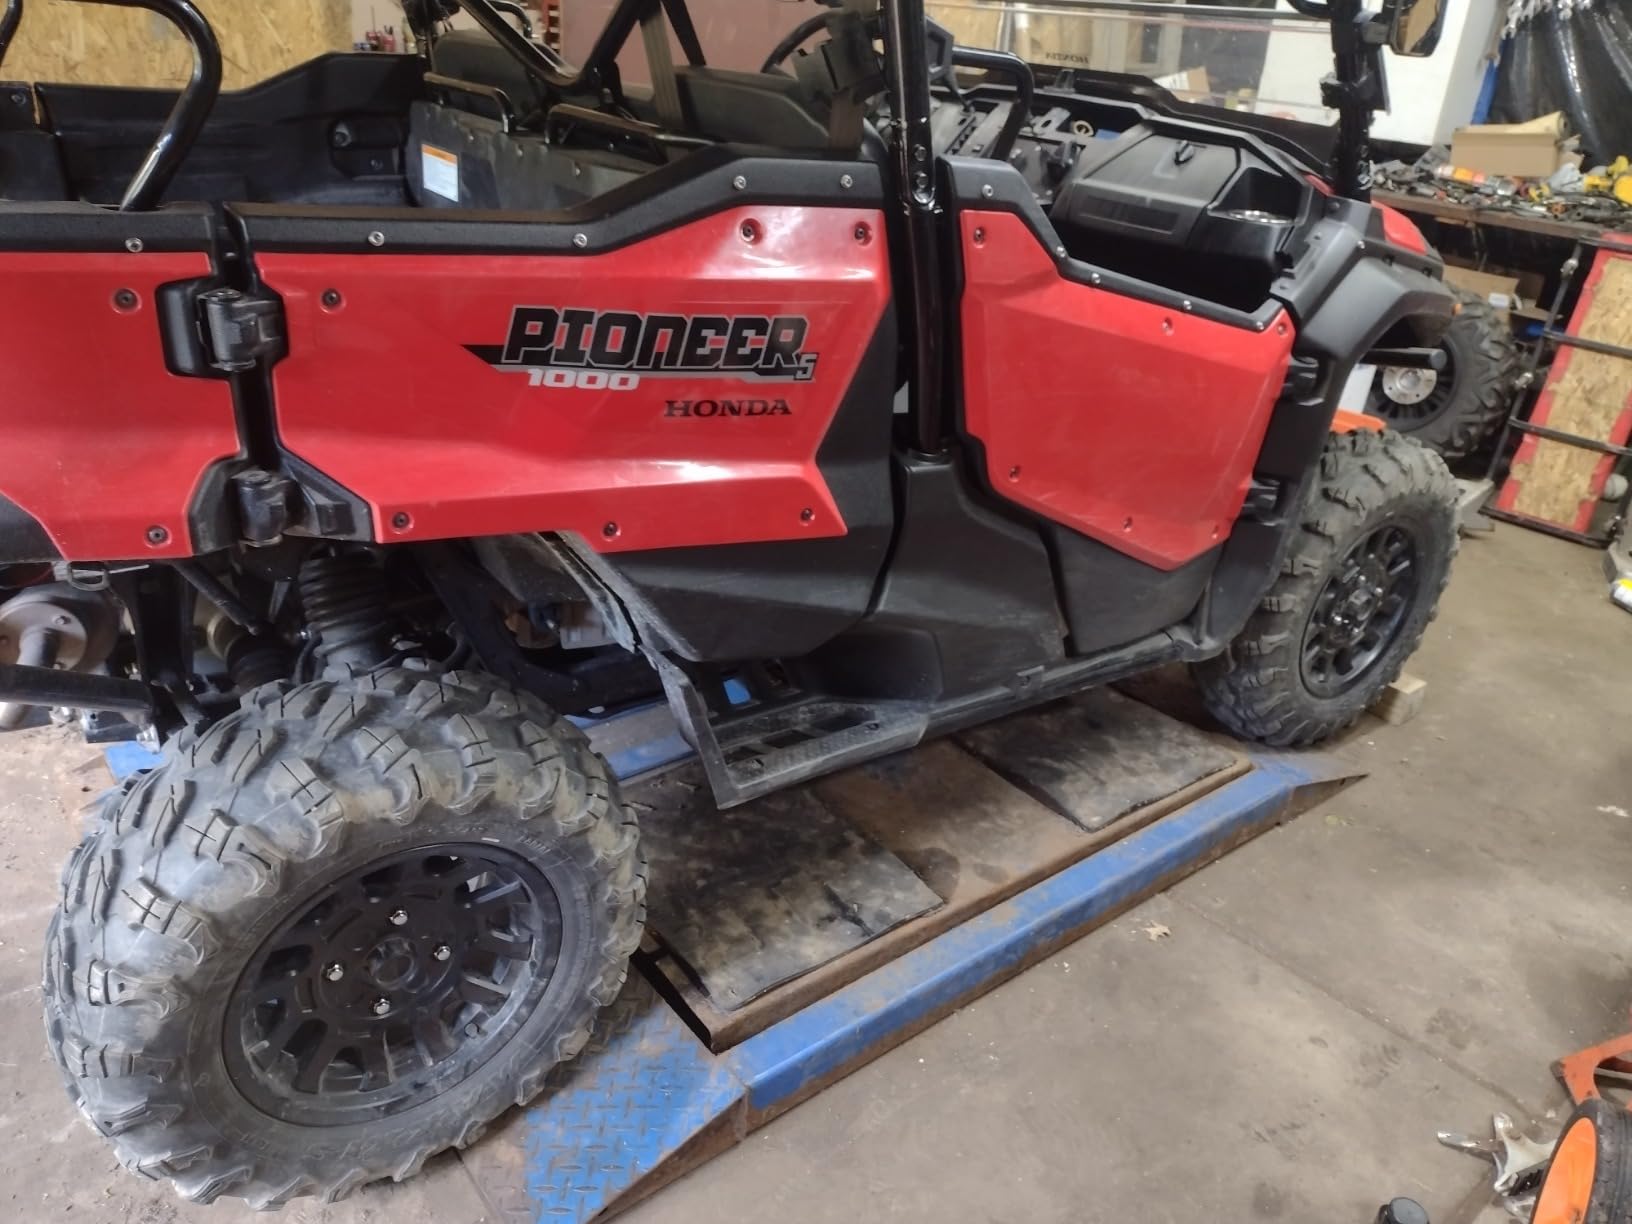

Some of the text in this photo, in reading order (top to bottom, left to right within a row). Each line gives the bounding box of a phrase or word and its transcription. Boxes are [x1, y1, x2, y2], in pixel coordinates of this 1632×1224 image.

[501, 304, 810, 369] PIONEER
[527, 368, 641, 391] 1000
[663, 398, 792, 417] HONDA
